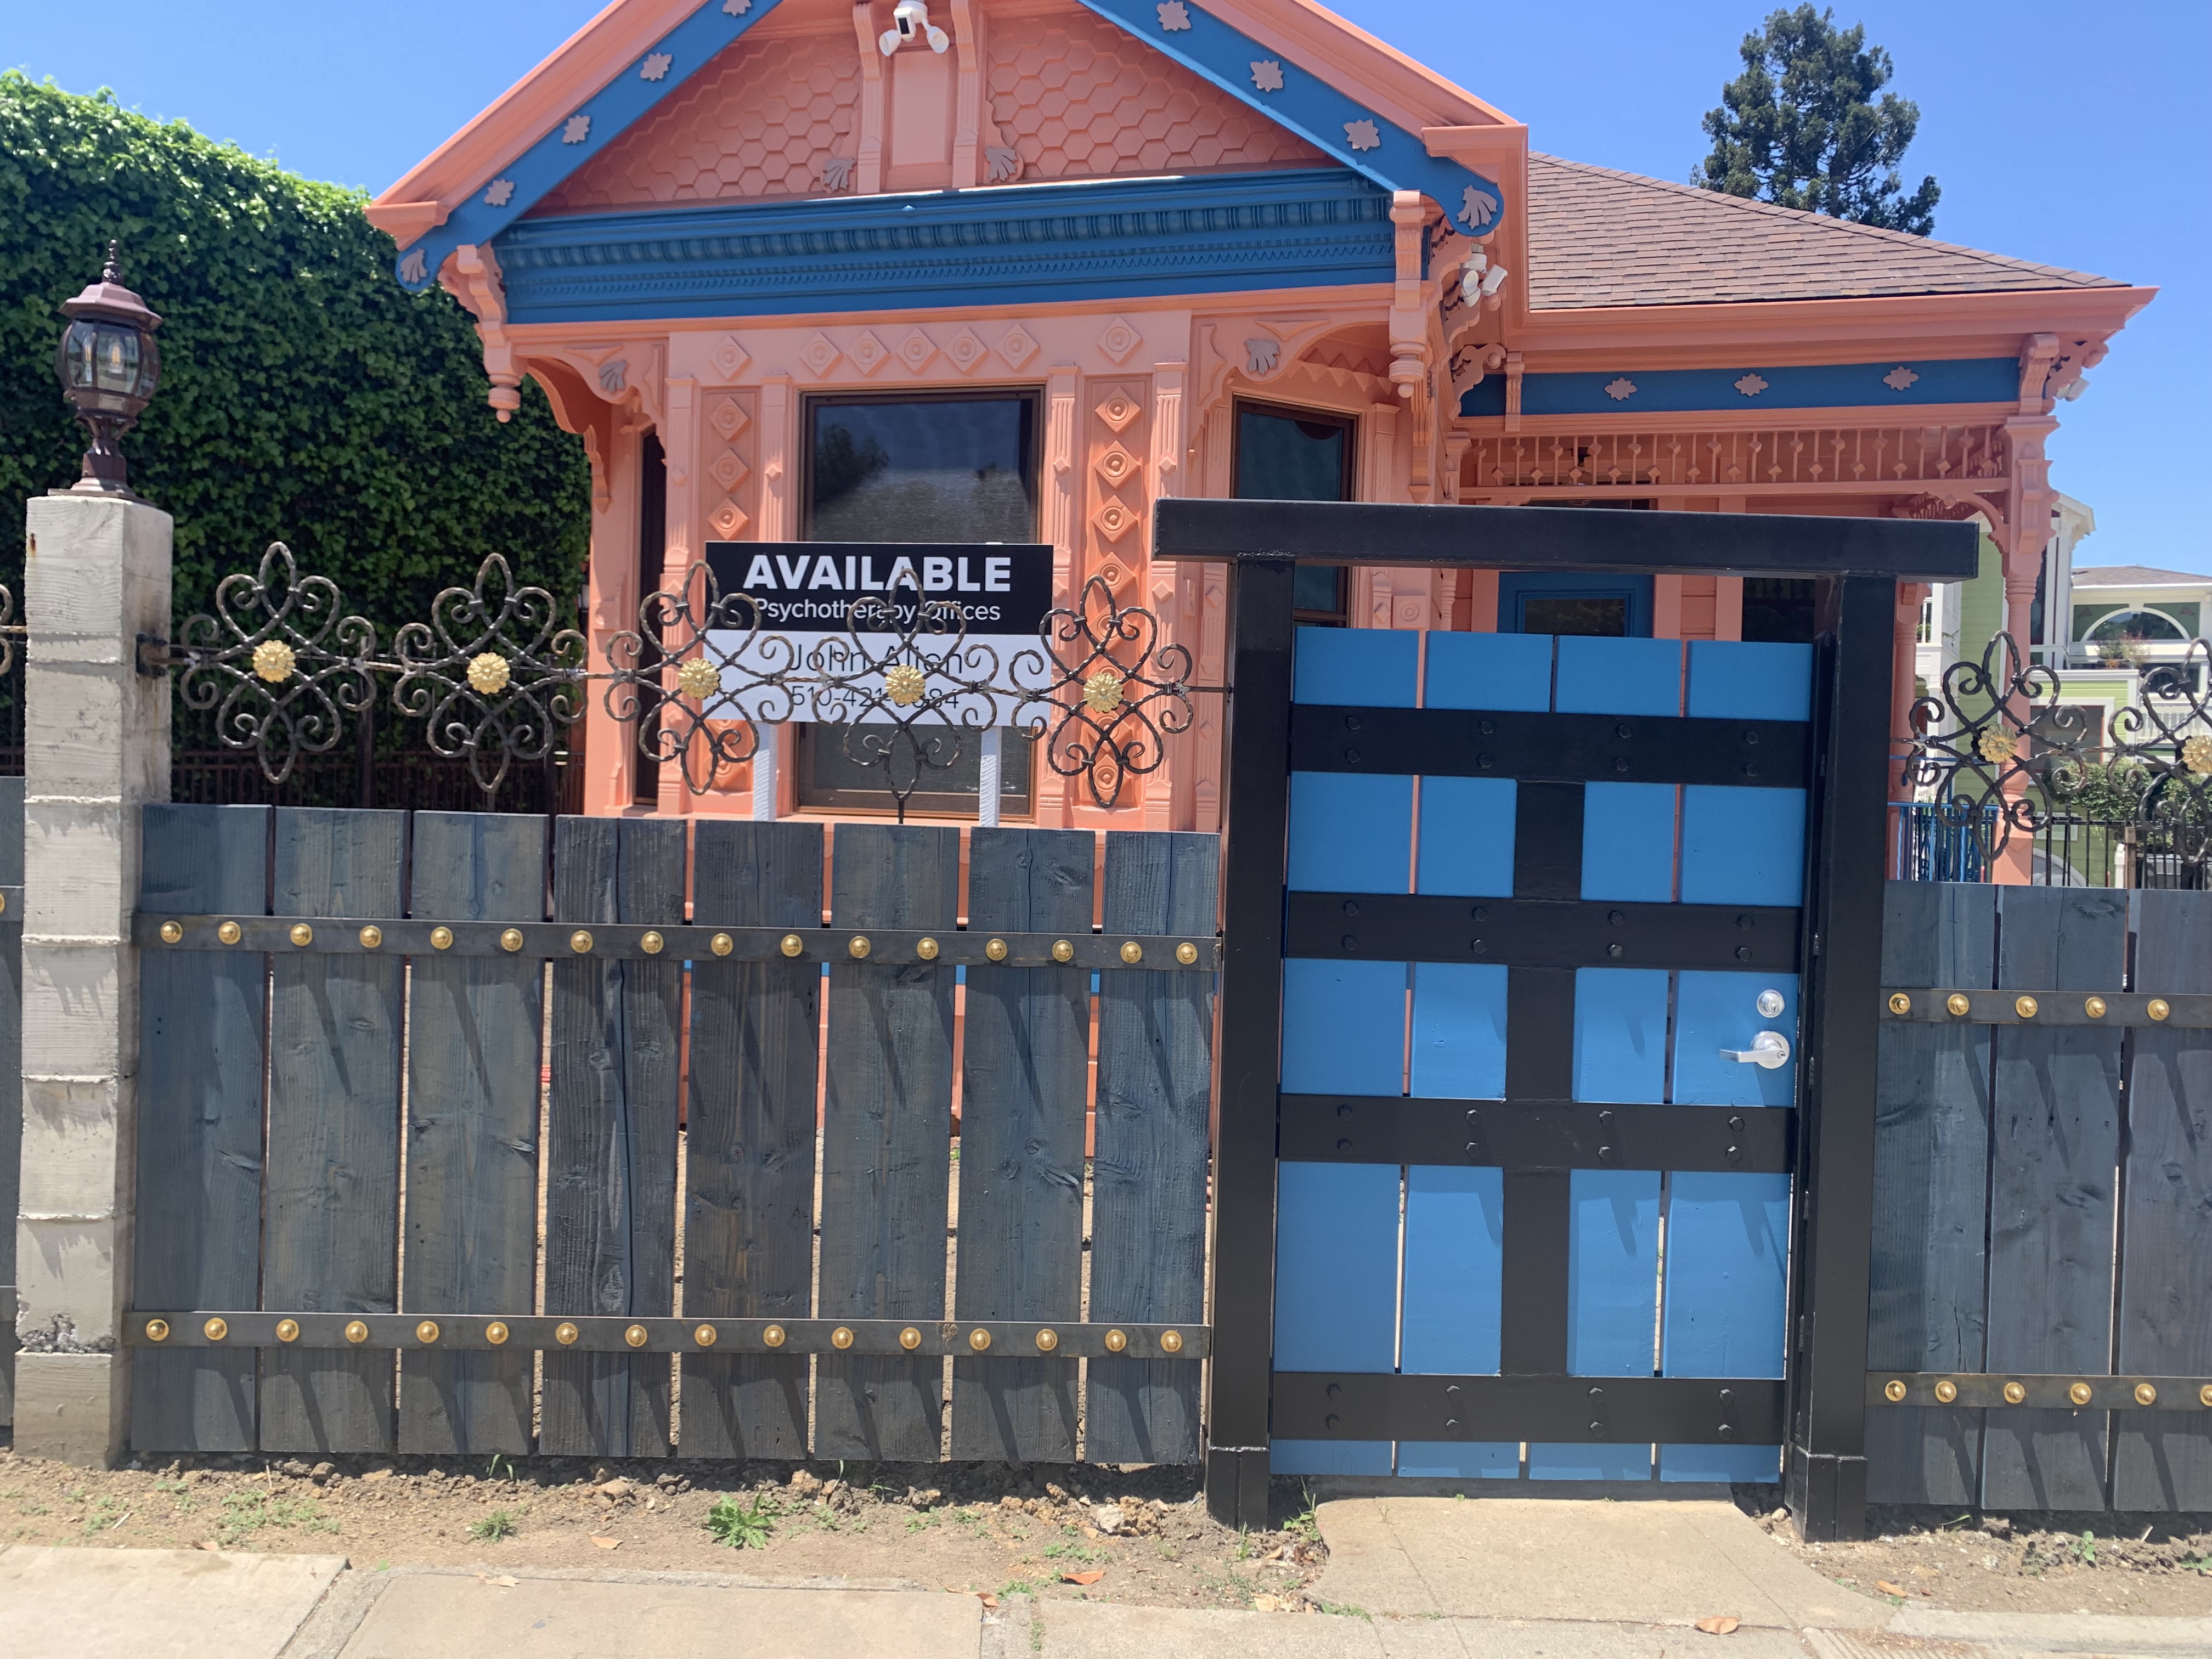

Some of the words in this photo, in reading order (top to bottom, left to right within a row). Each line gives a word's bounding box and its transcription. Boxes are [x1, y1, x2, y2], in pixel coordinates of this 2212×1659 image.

[743, 554, 1011, 592] AVAILABLE
[789, 644, 866, 672] John
[878, 646, 962, 674] Allen
[792, 686, 959, 709] 510-421-84
